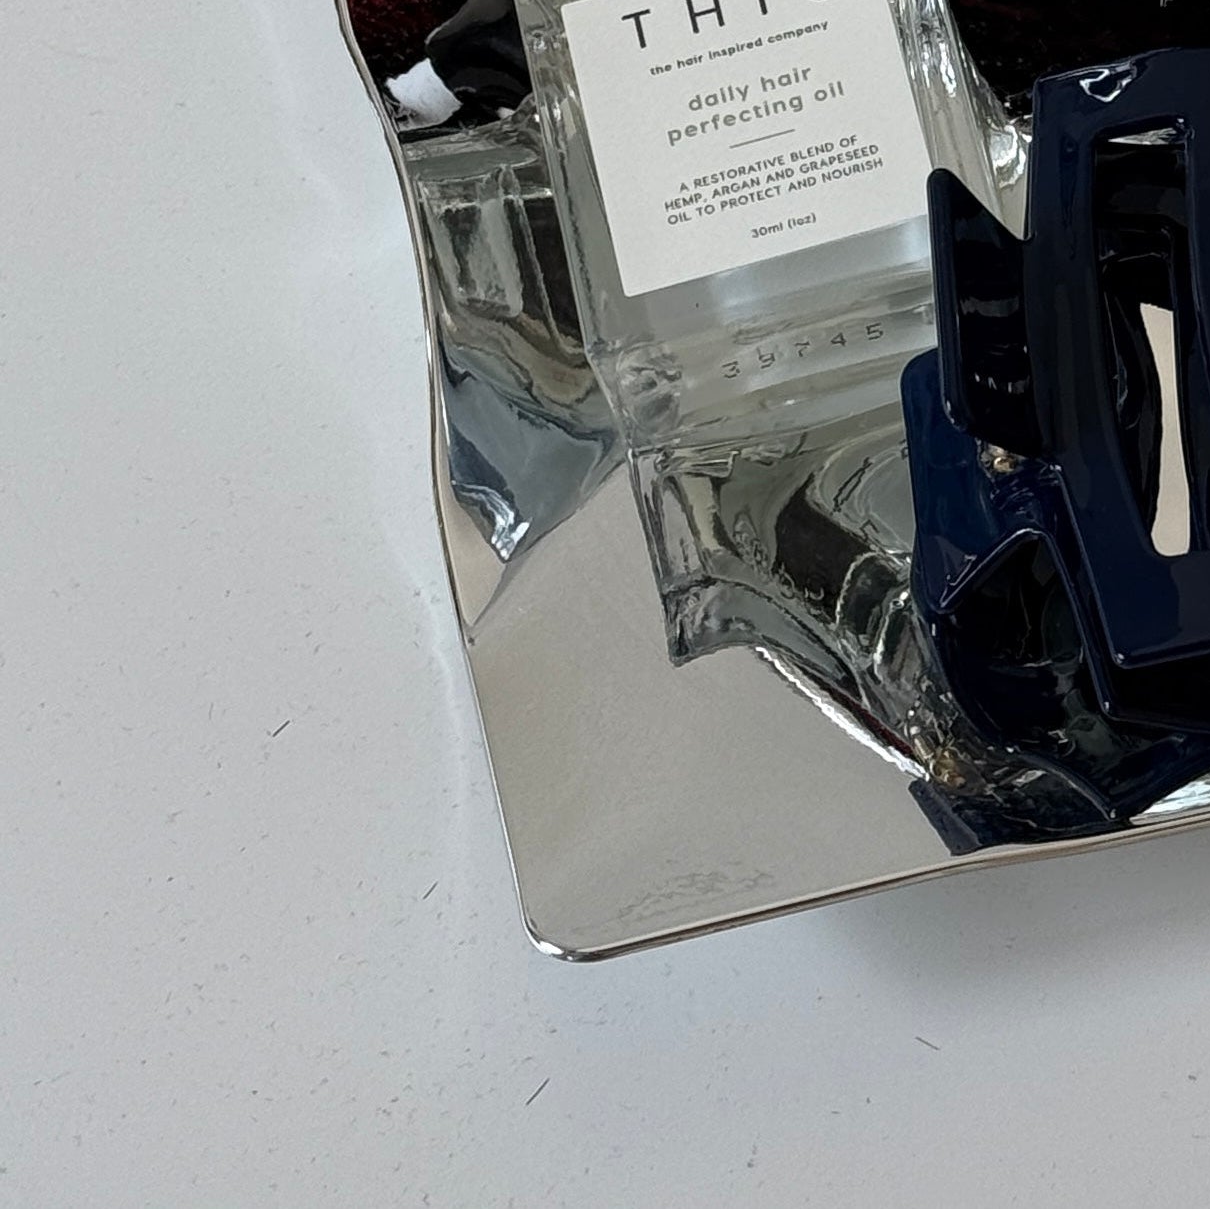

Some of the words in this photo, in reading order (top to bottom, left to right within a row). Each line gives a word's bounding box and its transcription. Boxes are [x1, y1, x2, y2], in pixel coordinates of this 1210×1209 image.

[650, 63, 672, 76] the
[677, 54, 703, 69] hair
[709, 38, 763, 60] inspired
[767, 21, 829, 43] company
[667, 95, 803, 146] perfecting
[814, 81, 845, 102] oil
[688, 84, 749, 111] daily
[760, 67, 812, 92] hair
[664, 191, 708, 212] HEMP,
[712, 177, 760, 199] ARGAN
[765, 167, 795, 184] AND
[799, 144, 879, 174] GRAPESEED
[667, 212, 692, 225] OIL
[696, 204, 715, 217] TO
[720, 184, 782, 211] PROTECT
[787, 176, 817, 192] AND
[821, 157, 884, 184] NOURISH
[679, 182, 691, 193] A
[693, 155, 786, 189] RESTORATIVE
[790, 142, 835, 163] BLEND
[839, 134, 858, 149] OF
[751, 223, 784, 239] 30ml
